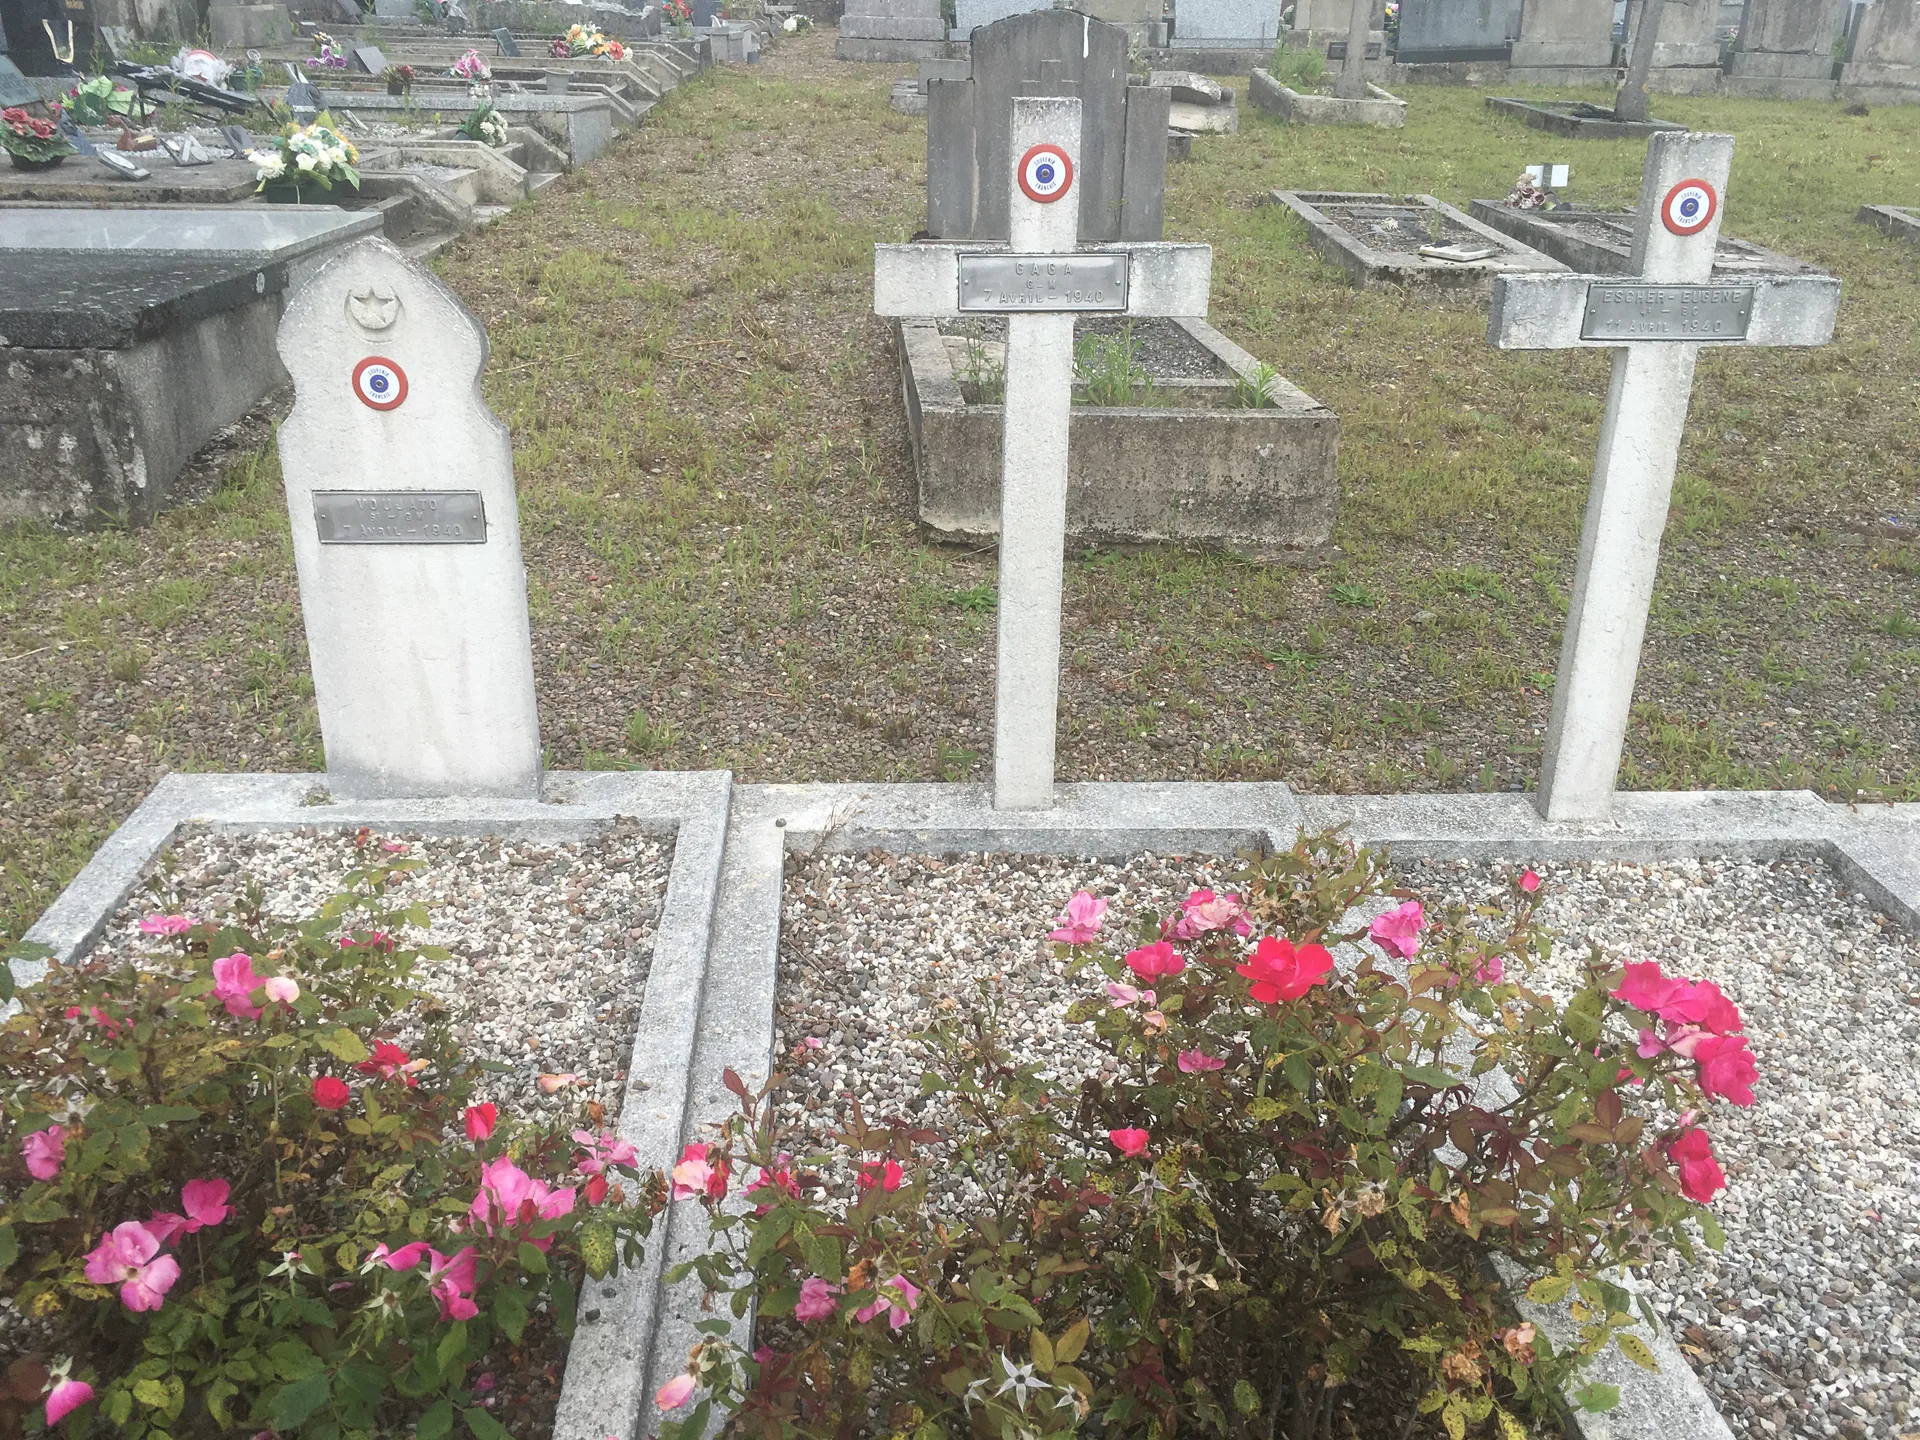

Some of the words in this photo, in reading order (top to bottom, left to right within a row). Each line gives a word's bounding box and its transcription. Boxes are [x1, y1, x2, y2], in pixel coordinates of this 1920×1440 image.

[1033, 156, 1056, 167] SOUVENIR
[1680, 191, 1703, 200] SOUVENIR
[1015, 262, 1074, 276] GAGA
[983, 288, 993, 302] 7
[1065, 289, 1105, 304] 1940
[1681, 290, 1742, 304] EUGENE
[1605, 319, 1621, 333] 11
[1628, 319, 1669, 333] AVRIL
[1682, 319, 1722, 333] 1940
[367, 367, 390, 377] SOUVENIR
[342, 524, 352, 538] 7
[422, 523, 462, 537] 1940
